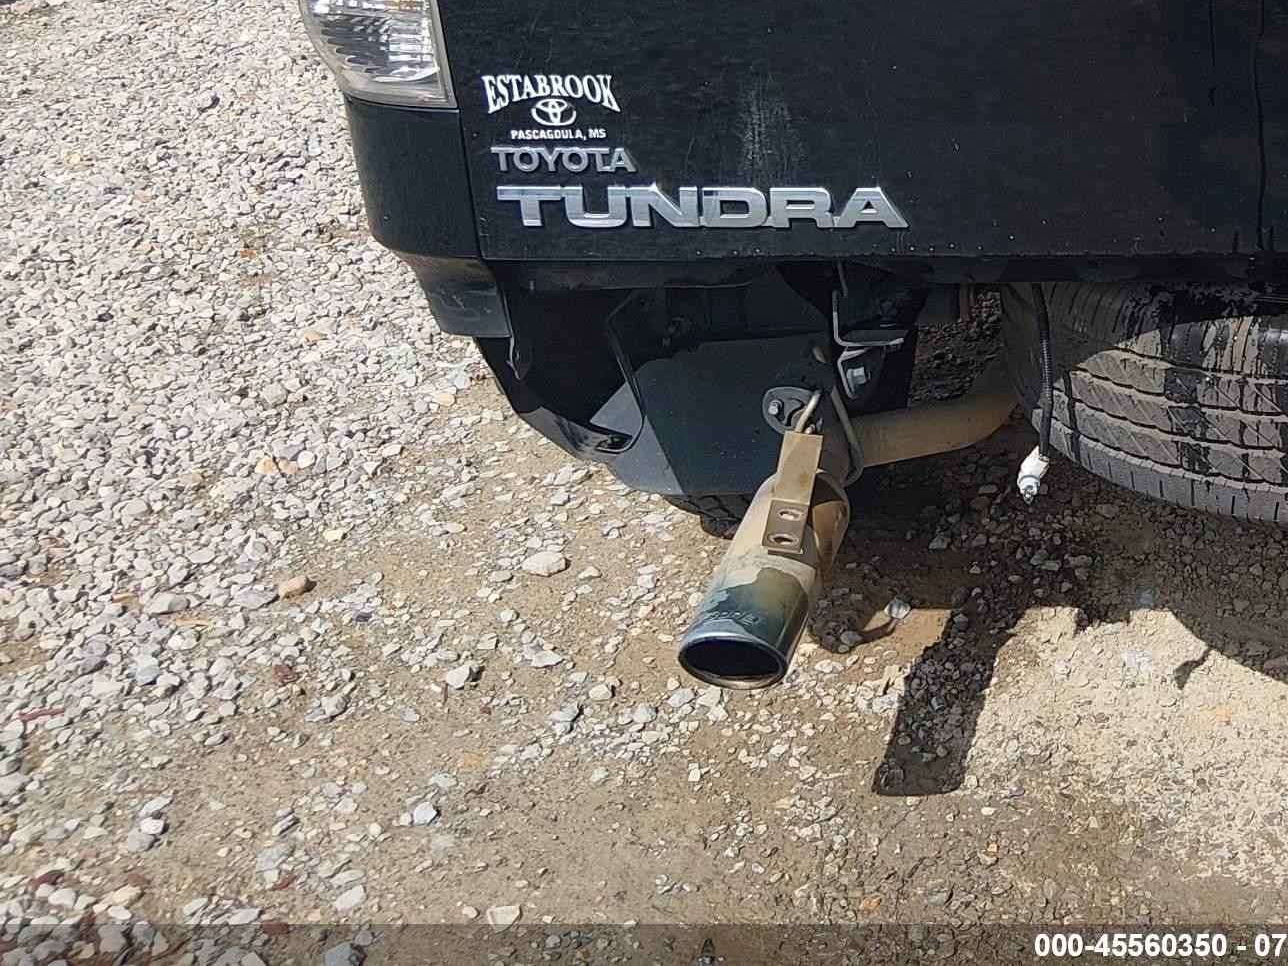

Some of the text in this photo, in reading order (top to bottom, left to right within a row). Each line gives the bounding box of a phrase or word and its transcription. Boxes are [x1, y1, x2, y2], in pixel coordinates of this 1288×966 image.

[481, 73, 622, 115] ESTABROOK
[510, 128, 607, 141] PASCAGOULA, MS
[490, 146, 637, 173] TOYOTA
[496, 183, 910, 229] TUNDRA
